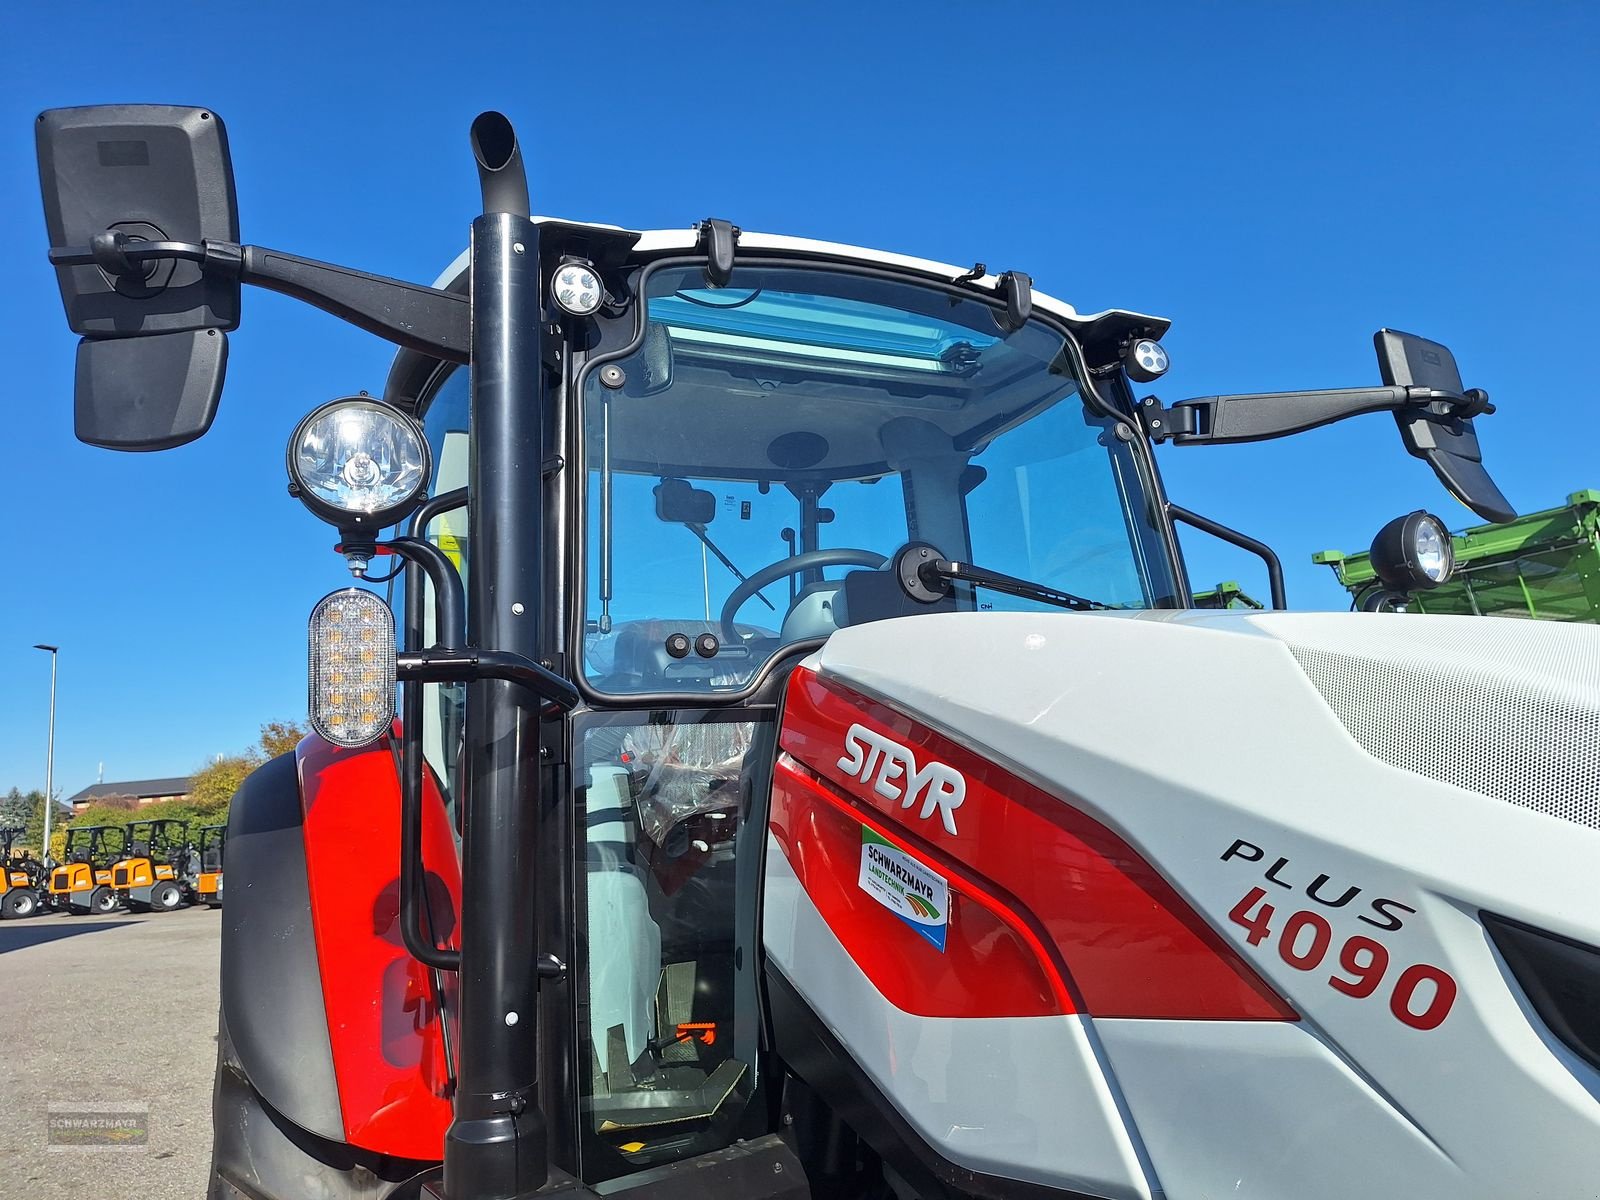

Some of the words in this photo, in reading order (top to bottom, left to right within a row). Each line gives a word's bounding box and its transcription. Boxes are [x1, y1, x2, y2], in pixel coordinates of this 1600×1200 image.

[836, 722, 966, 836] STEYR
[868, 845, 934, 902] SCHWARZMAYR
[868, 862, 906, 896] LANDTECHNIK
[1220, 838, 1417, 932] PLUS
[1228, 886, 1457, 1031] 4090
